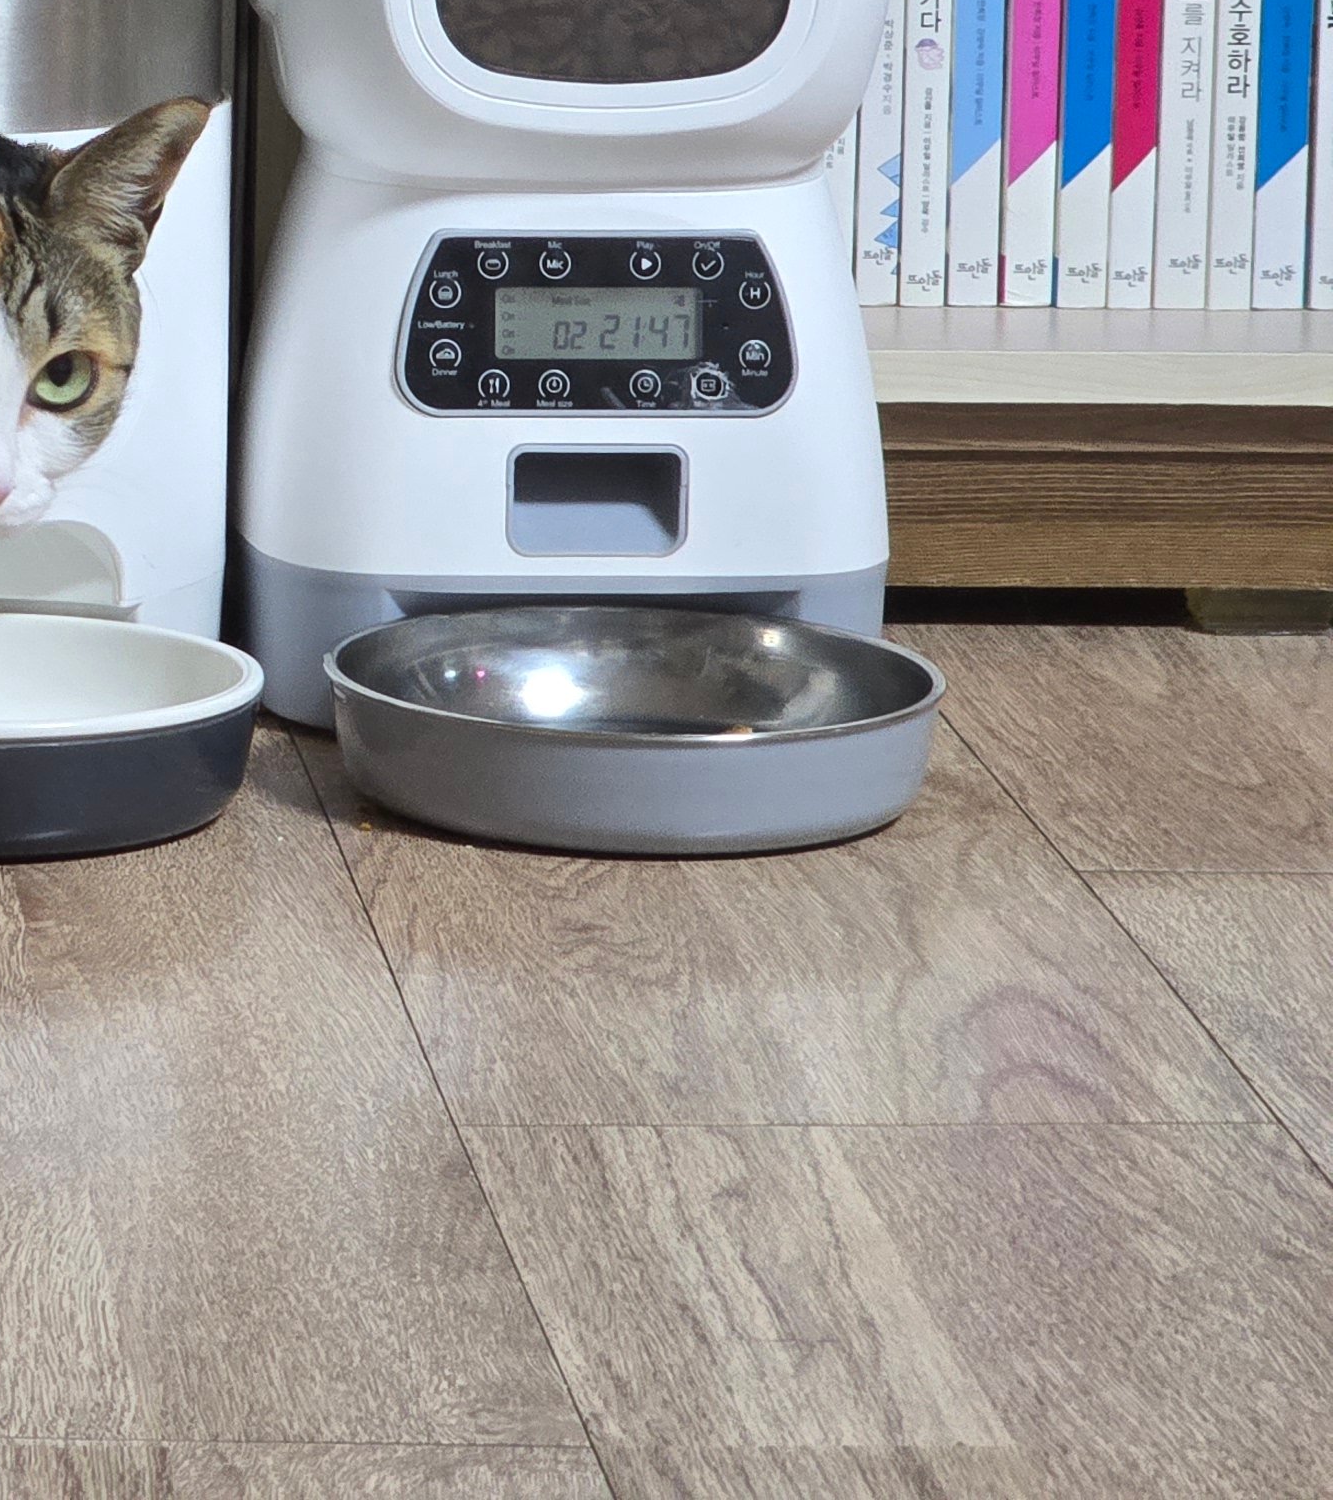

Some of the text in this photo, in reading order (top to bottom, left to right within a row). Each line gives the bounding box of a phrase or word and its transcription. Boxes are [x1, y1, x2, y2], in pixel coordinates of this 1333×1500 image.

[473, 241, 512, 250] Breakfast
[433, 270, 459, 280] Lunch
[431, 367, 459, 378] Dinner
